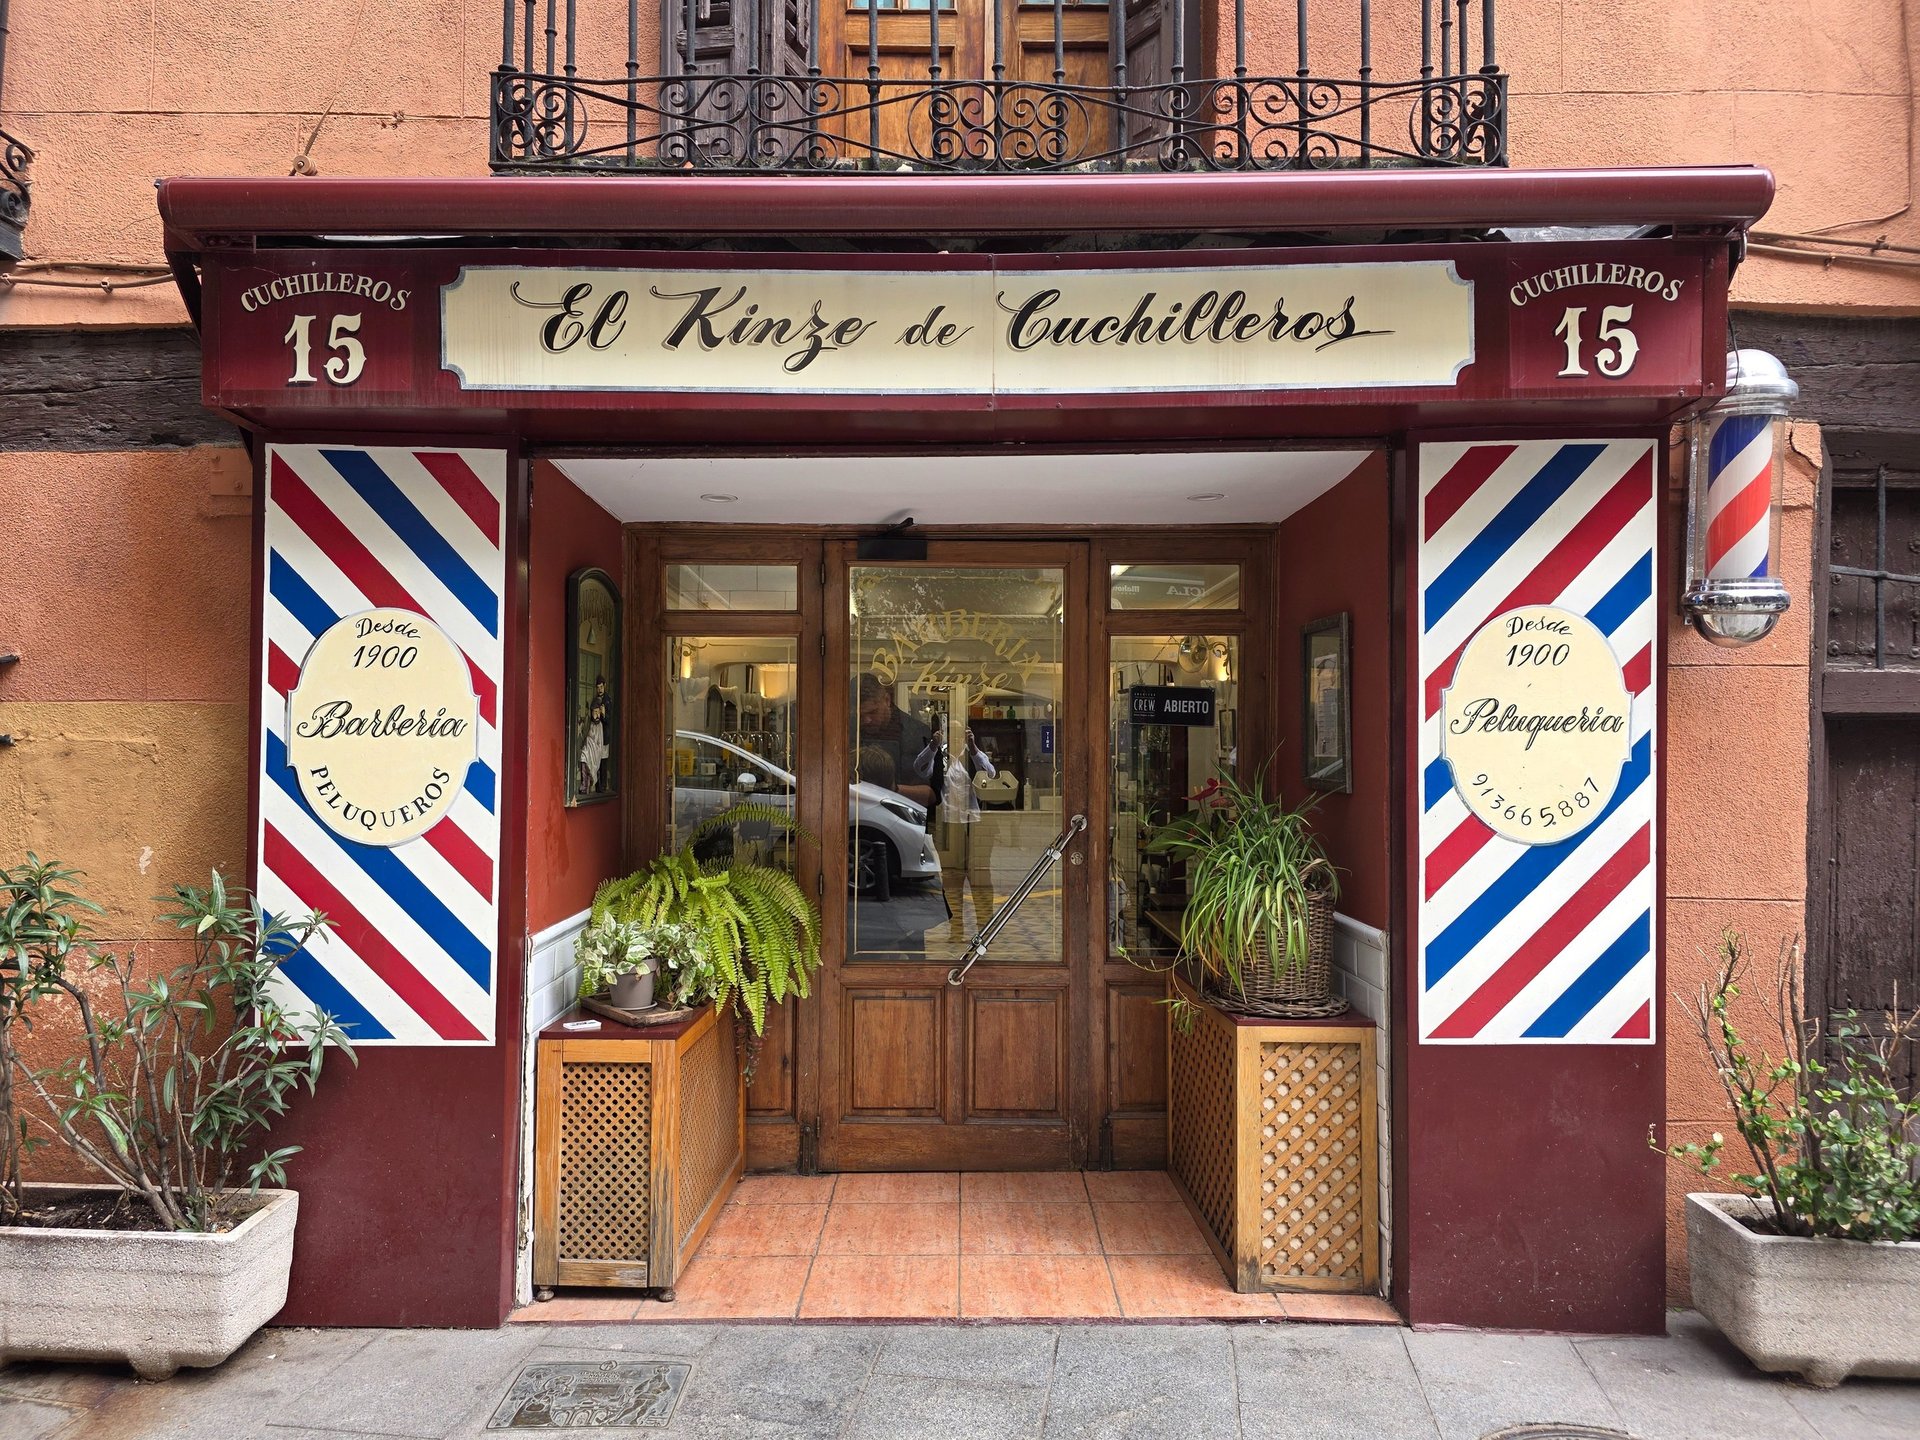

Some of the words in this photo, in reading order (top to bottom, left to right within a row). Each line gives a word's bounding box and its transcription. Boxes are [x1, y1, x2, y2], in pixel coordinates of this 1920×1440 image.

[241, 272, 411, 312] CUCHILLEROS
[1510, 263, 1684, 306] CUCHILLEROS
[510, 281, 629, 352] El
[650, 286, 877, 373] Kinze
[895, 305, 974, 346] de
[996, 289, 1395, 352] Cuchilleros
[1555, 304, 1640, 376] 15
[284, 312, 367, 384] 15
[355, 618, 421, 639] Desde
[1506, 616, 1573, 637] Desde
[353, 645, 418, 668] 1900
[1506, 643, 1570, 667] 1900
[910, 656, 1012, 706] Kinze
[1164, 699, 1209, 714] ABIERTO
[310, 765, 450, 831] PELUQUEROS
